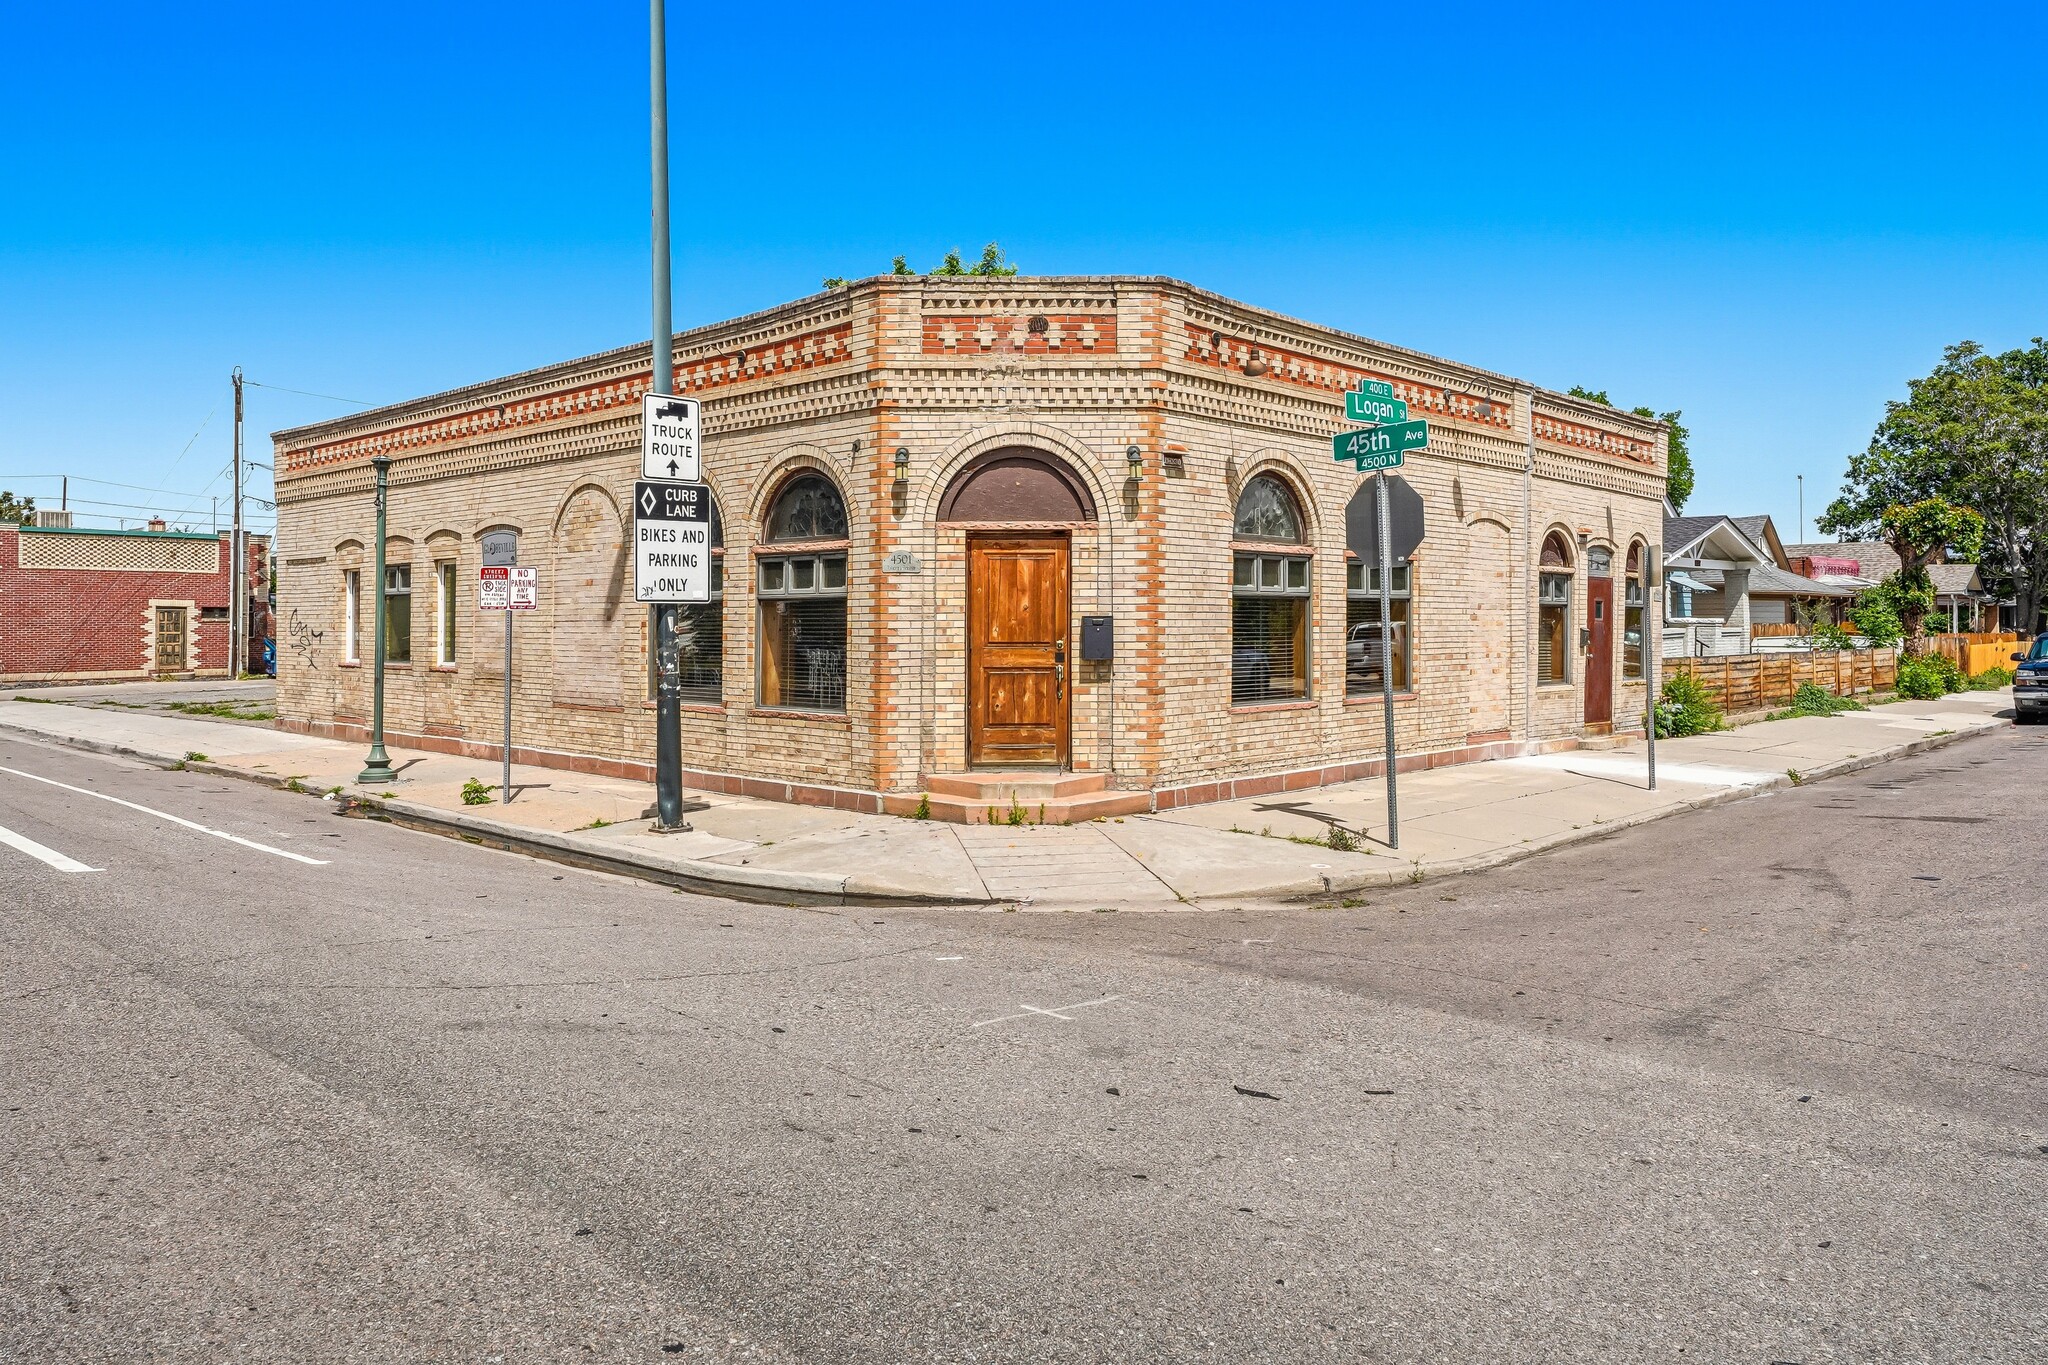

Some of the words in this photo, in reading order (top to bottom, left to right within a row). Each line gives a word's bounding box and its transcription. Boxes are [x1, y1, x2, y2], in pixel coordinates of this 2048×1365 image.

[1368, 383, 1383, 395] 400
[1384, 385, 1388, 396] E
[1355, 394, 1394, 421] Logan
[1399, 409, 1406, 420] St
[652, 424, 692, 440] TRUCK
[652, 442, 692, 458] ROUTE
[1346, 431, 1390, 455] 45th
[1404, 430, 1424, 442] Ave
[1361, 455, 1387, 469] 4500
[1389, 453, 1397, 465] N
[665, 488, 698, 502] CURB
[666, 504, 697, 518] LANE
[641, 528, 676, 543] BIKES
[681, 530, 705, 544] AND
[648, 552, 698, 568] PARKING
[890, 554, 912, 565] 4501
[517, 569, 529, 578] NO
[511, 579, 536, 588] PARKING
[659, 578, 688, 592] ONLY
